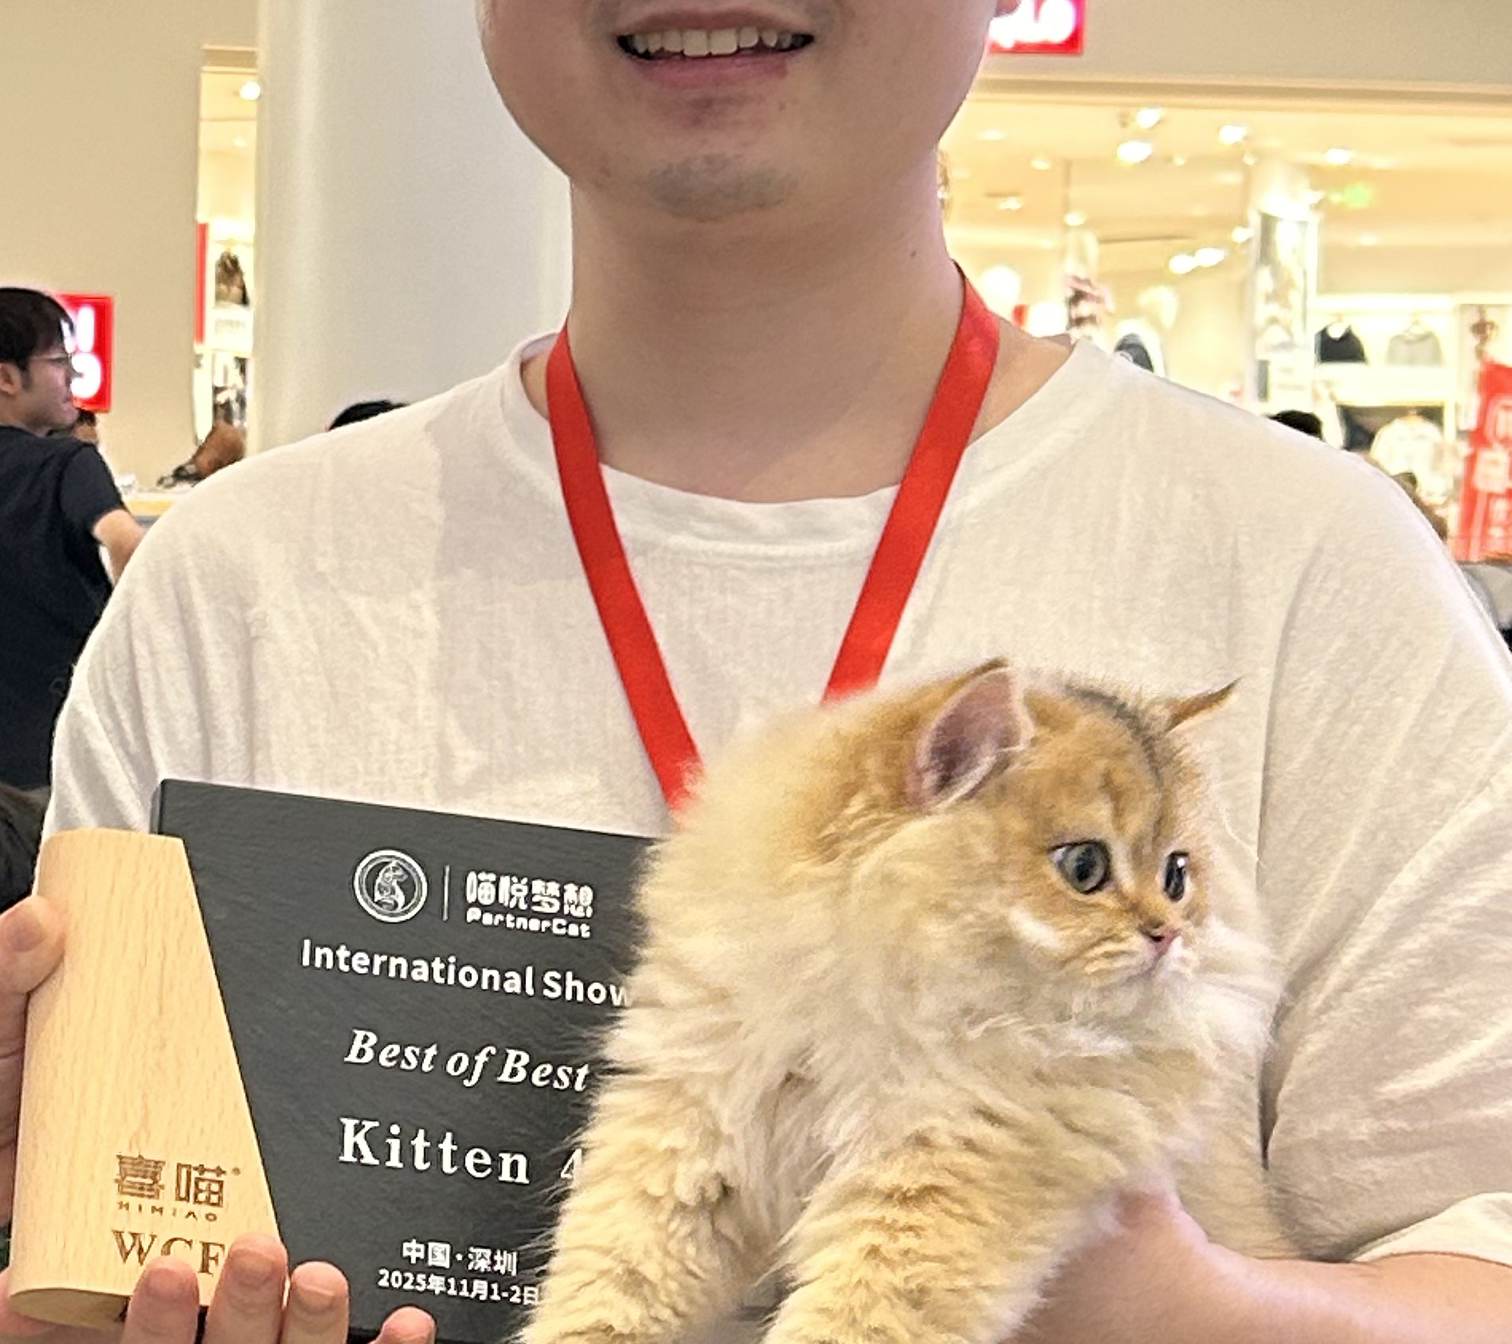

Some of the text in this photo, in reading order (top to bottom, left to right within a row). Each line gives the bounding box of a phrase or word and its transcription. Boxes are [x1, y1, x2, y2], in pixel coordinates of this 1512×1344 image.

[465, 870, 593, 918] 喵悦梦想
[465, 906, 591, 939] PartnerCat
[301, 939, 634, 1007] International Show
[344, 1028, 590, 1092] Best of Best
[338, 1117, 530, 1185] Kitten
